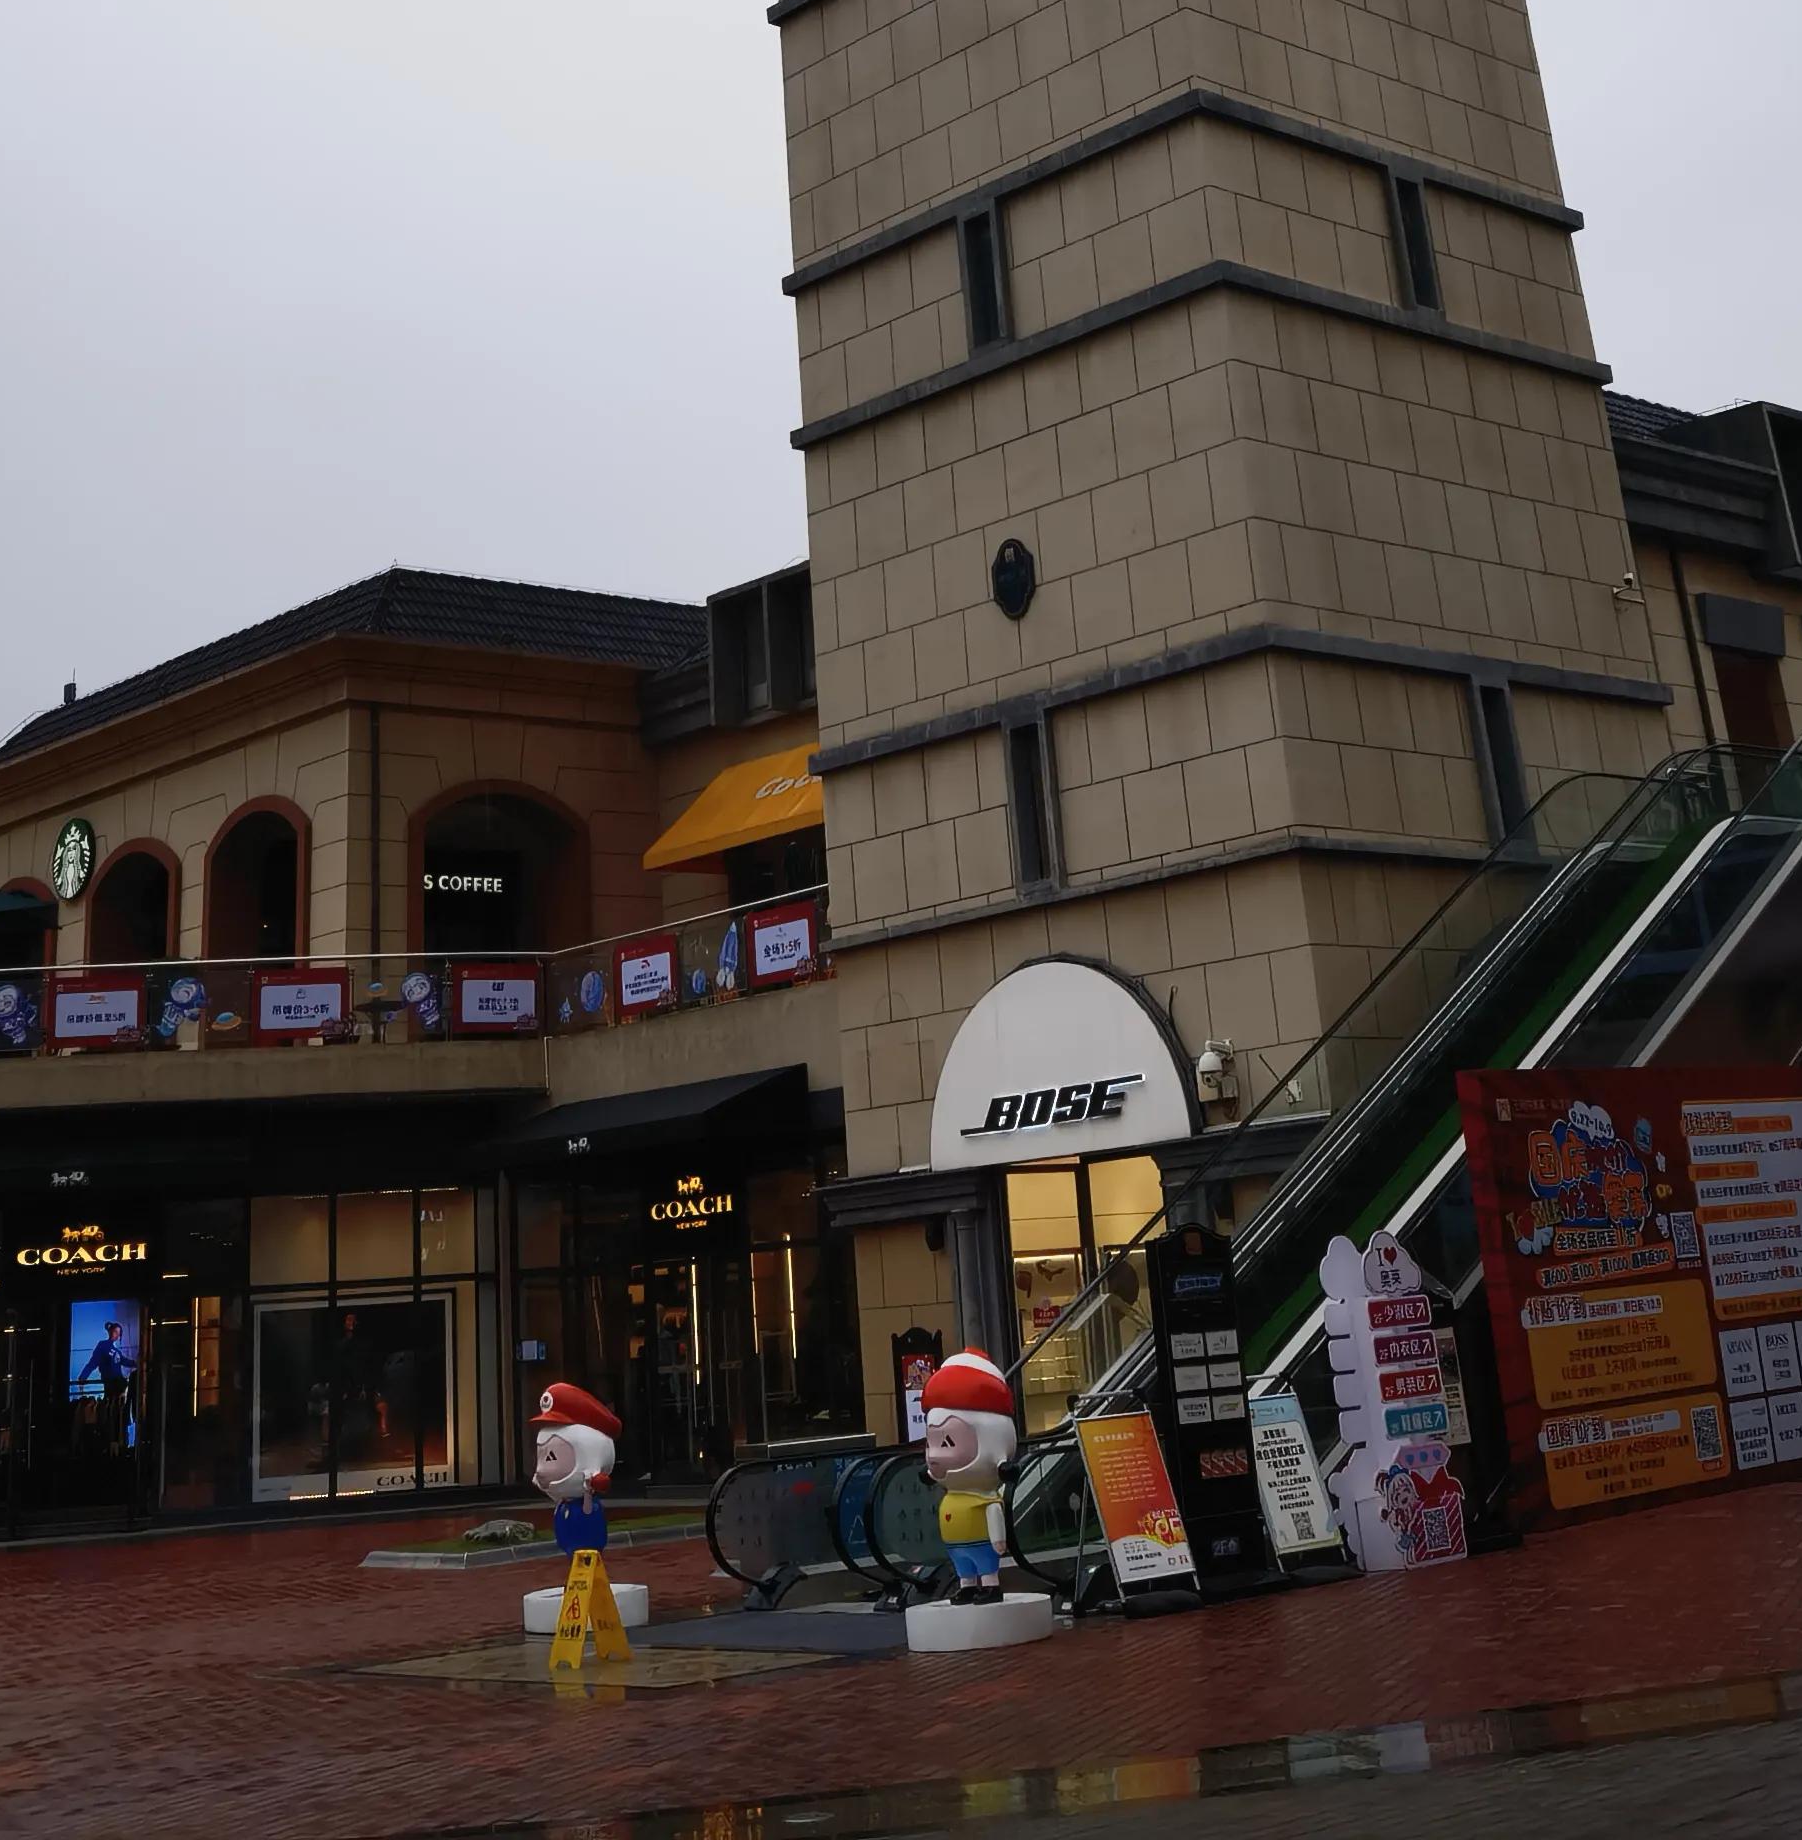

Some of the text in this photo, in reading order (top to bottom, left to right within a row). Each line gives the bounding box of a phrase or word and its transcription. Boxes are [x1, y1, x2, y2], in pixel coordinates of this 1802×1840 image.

[437, 875, 504, 893] COFFEE
[960, 1073, 1146, 1138] BOSE
[650, 1194, 734, 1221] COACH
[15, 1241, 150, 1267] COACH
[1375, 1247, 1383, 1267] I
[56, 1265, 107, 1277] NEW YORK
